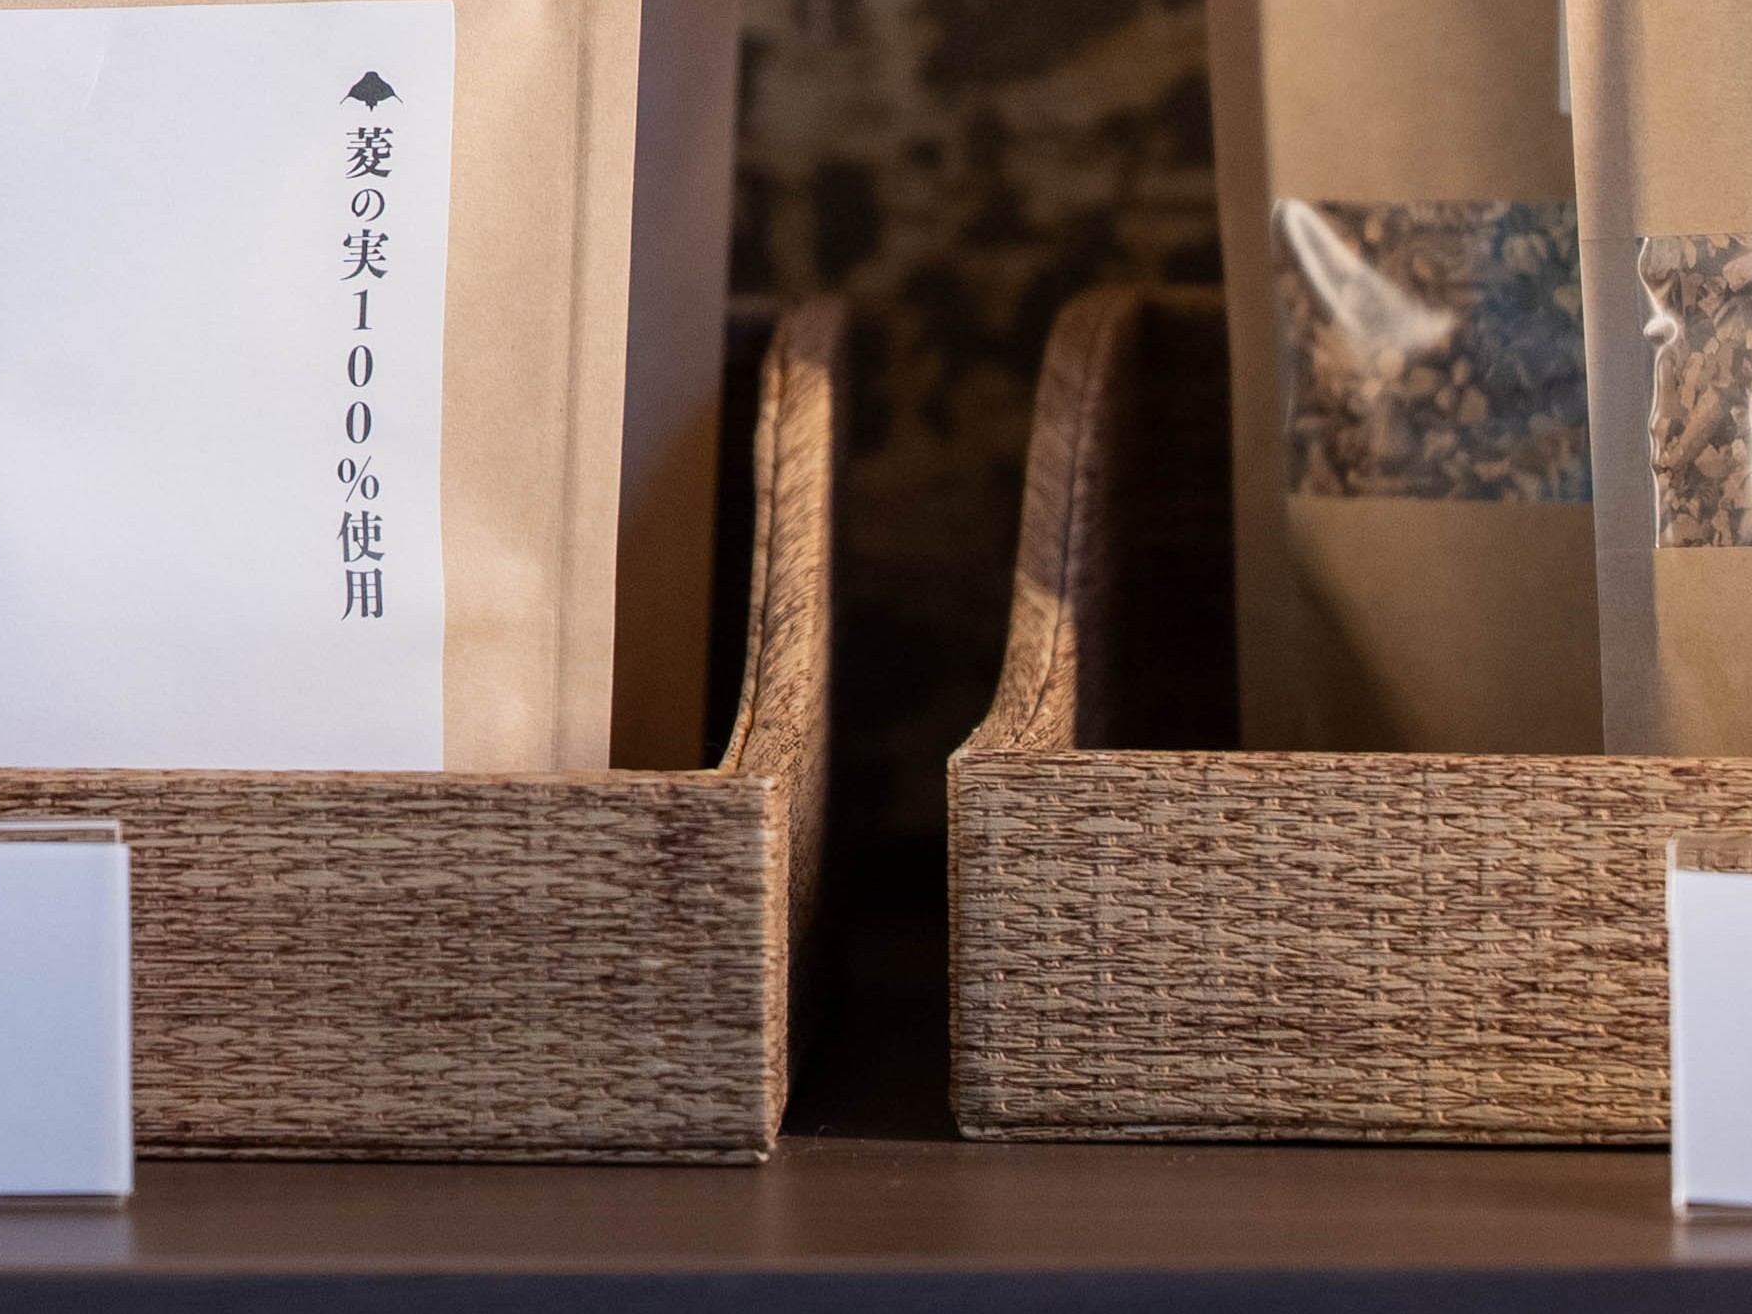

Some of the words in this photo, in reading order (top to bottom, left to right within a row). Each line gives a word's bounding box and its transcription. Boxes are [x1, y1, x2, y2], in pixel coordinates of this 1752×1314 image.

[336, 125, 395, 622] 菱の実100%使用
